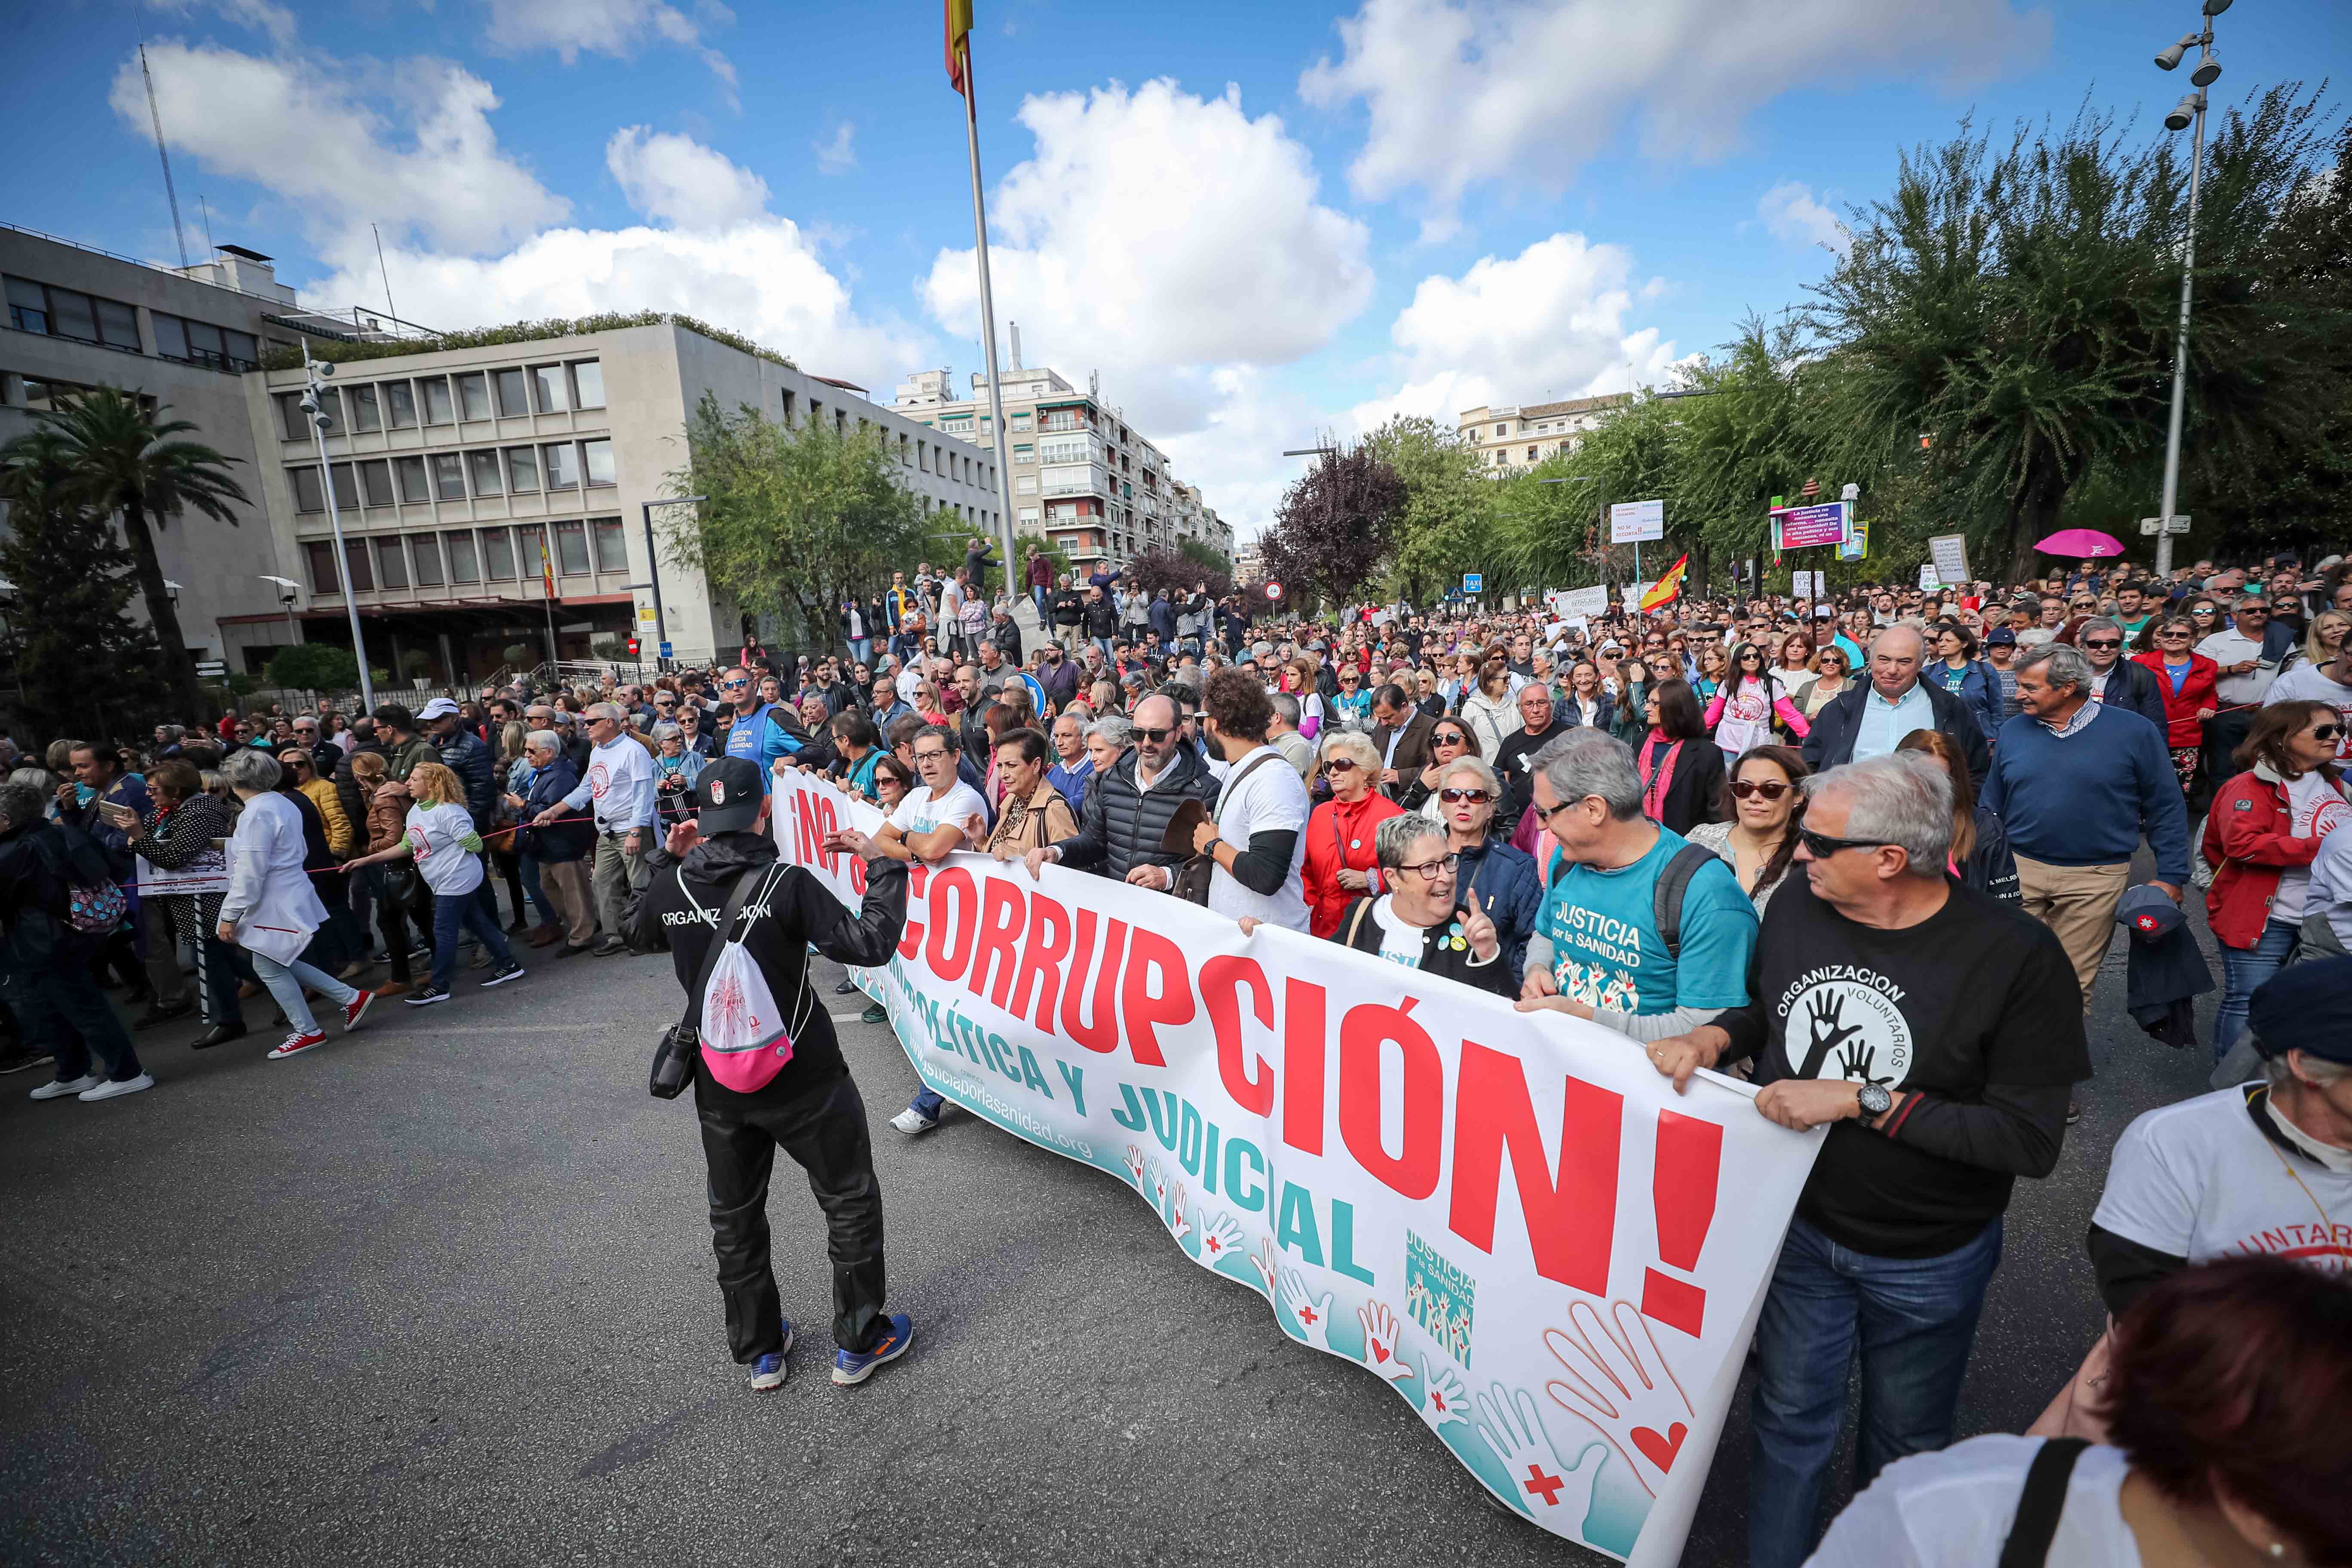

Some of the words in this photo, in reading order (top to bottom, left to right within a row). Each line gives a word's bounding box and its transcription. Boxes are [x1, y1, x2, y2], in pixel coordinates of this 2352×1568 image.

[662, 904, 772, 926] ORGANIZCION
[1556, 901, 1641, 951] JUSTICIA
[1553, 927, 1565, 939] por
[1565, 930, 1573, 944] la
[1575, 932, 1640, 968] SANIDAD
[1777, 965, 1906, 1018] ORGANIZACION
[1847, 986, 1906, 1068] VOLUNTARIOS
[897, 863, 1723, 1338] CORRUPCIÓN!
[1055, 1059, 1087, 1118] Y
[1110, 1082, 1375, 1287] JUDICIAL
[1407, 1230, 1477, 1294] JUSTICIA
[1419, 1257, 1425, 1269] la
[1427, 1263, 1475, 1308] SANIDAD
